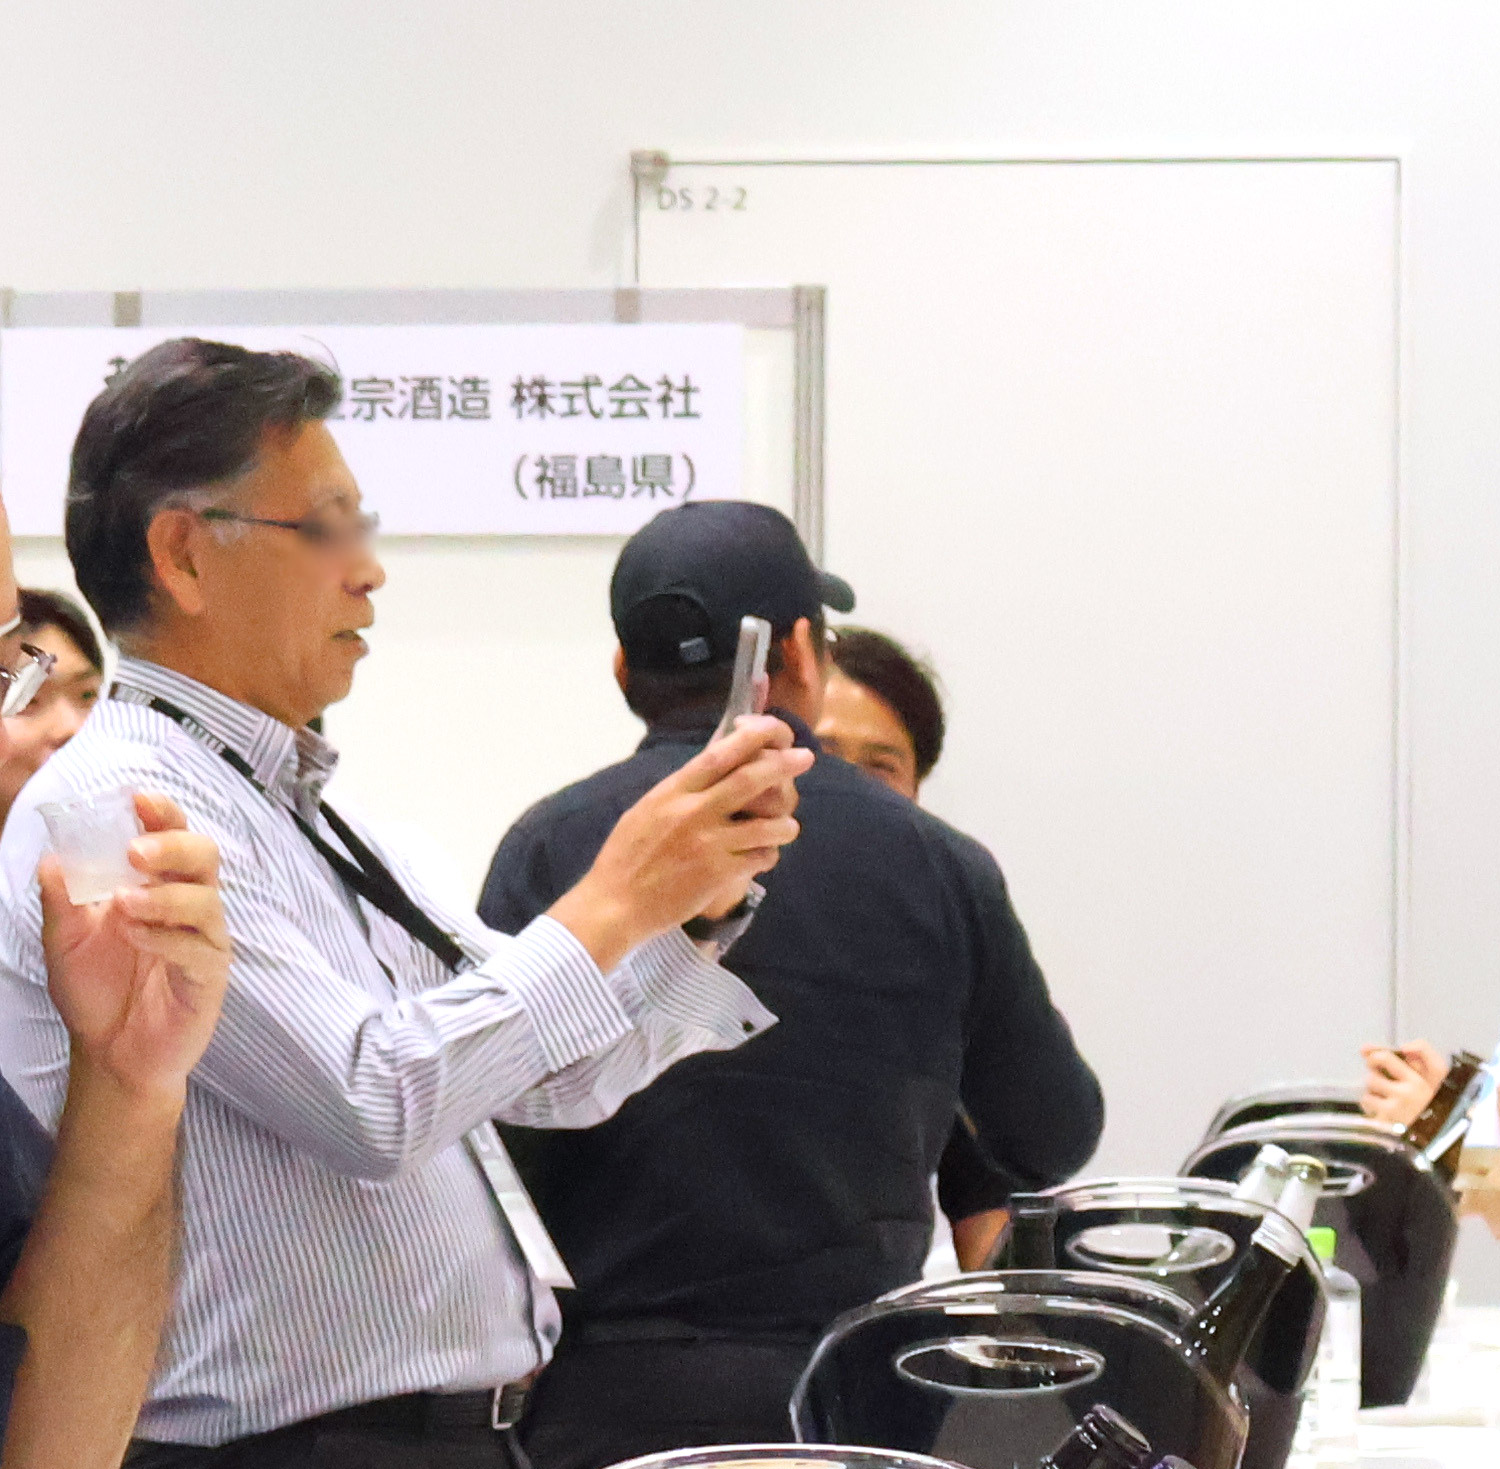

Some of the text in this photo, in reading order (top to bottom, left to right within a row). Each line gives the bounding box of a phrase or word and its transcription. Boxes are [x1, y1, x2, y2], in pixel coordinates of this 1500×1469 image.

[657, 185, 747, 211] DS 2-2
[326, 373, 702, 421] 宗酒造 株式会社
